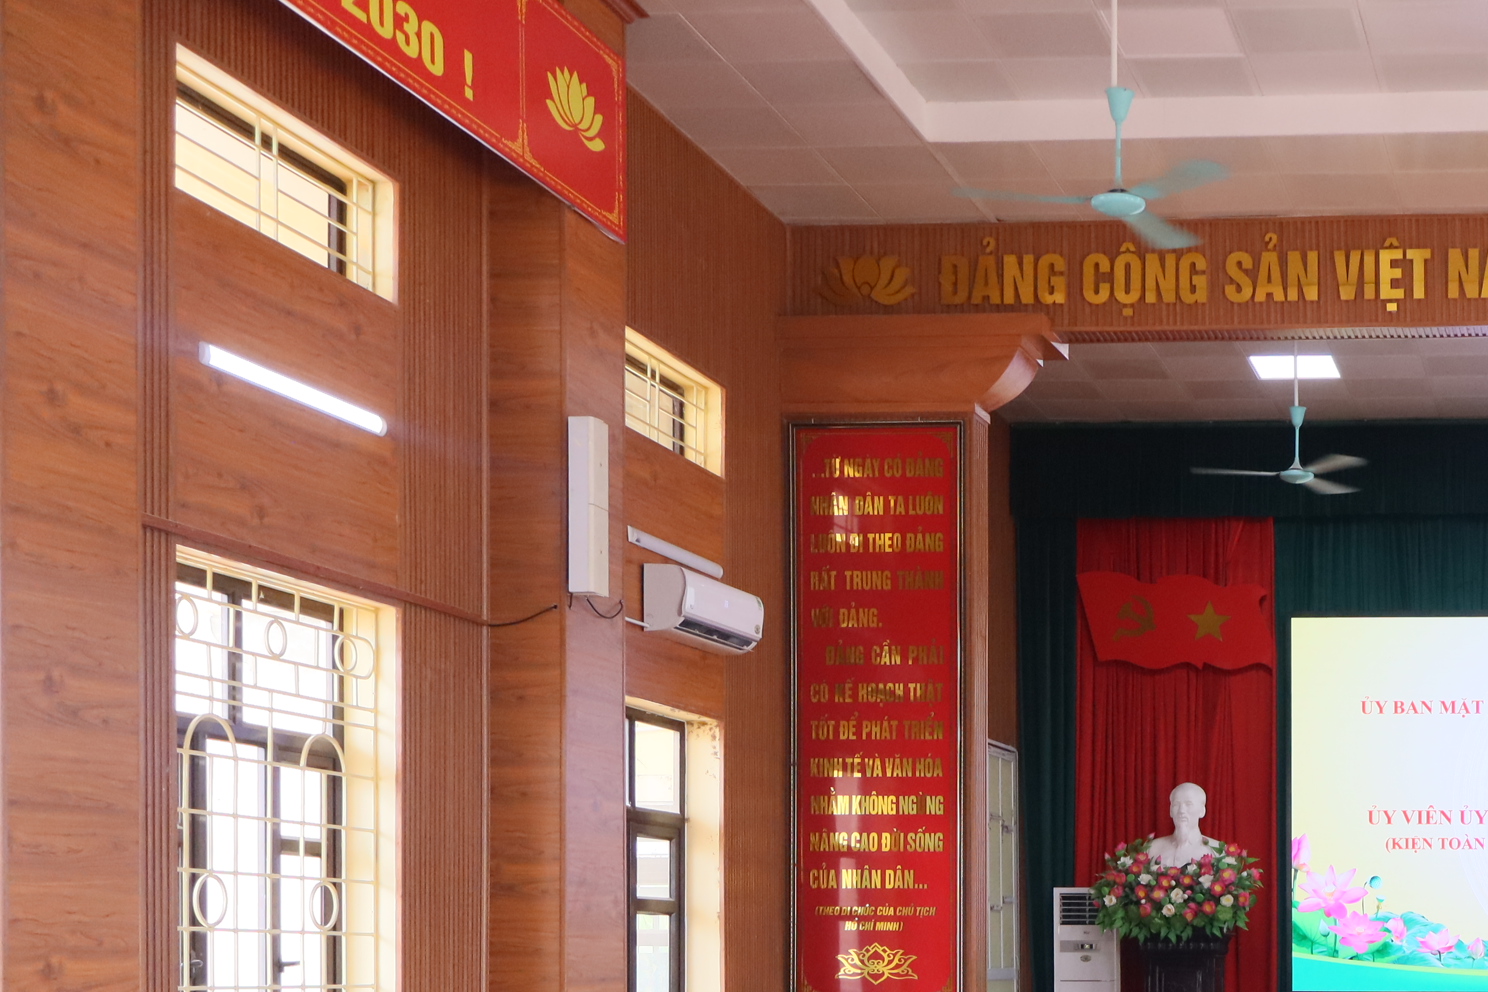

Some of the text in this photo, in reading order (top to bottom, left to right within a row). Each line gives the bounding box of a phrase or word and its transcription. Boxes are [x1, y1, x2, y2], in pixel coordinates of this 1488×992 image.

[341, 0, 444, 76] 030
[939, 236, 1066, 305] ĐẢNG
[1082, 242, 1207, 316] CỘNG
[1224, 232, 1319, 303] SẢN
[1333, 237, 1431, 311] VIỆT
[844, 451, 944, 478] NGÀY CÓ ĐẢNG
[811, 492, 944, 515] NHÂN TA LUÔN
[810, 527, 944, 553] LUÔN ĐI THEO ĐẢNG
[811, 565, 944, 590] RẤT TRUNG THÀNH
[839, 602, 882, 627] ĐẢNG.
[826, 639, 944, 665] ĐẢNG CẦN PHẢI
[811, 678, 943, 707] CÓ KẾ HOẠCH THẬT
[1361, 696, 1387, 714] ỦY
[1393, 700, 1433, 714] BAN
[1439, 699, 1484, 718] MẶT
[811, 712, 943, 740] TỐT ĐỂ PHÁT TRIỂN
[810, 752, 943, 777] KINH TẾ VÀ VĂN HÓA
[811, 787, 896, 815] NHẰM KHÔNG
[1368, 806, 1397, 825] ỦY
[1400, 805, 1453, 825] VIÊN
[1459, 805, 1488, 825] ỦY
[810, 826, 943, 852] NÂNG CAO ĐỜI SỐNG
[1386, 836, 1434, 853] (KIỆN
[1438, 834, 1485, 850] TOÀN
[810, 863, 881, 889] CỦA NHÂN
